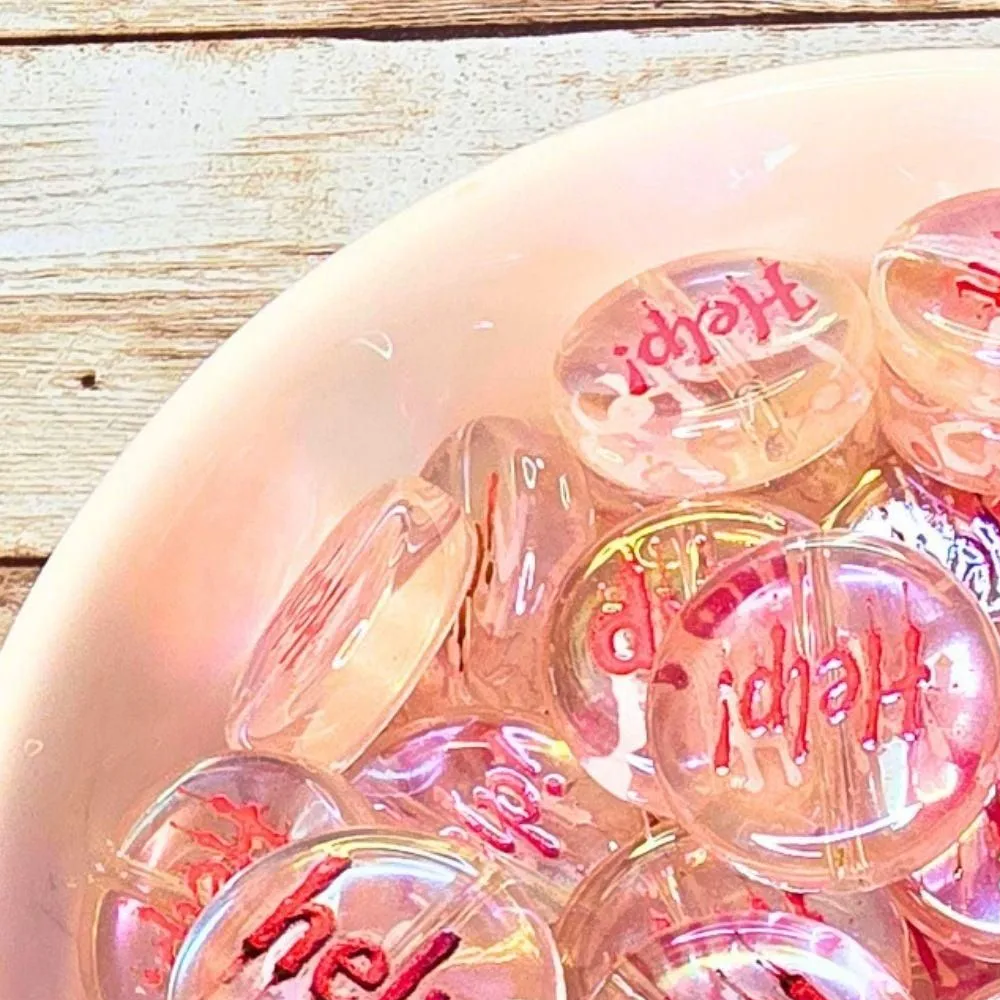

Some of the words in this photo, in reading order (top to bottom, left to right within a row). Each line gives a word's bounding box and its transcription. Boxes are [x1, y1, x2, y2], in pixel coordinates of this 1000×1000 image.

[612, 257, 818, 396] Help!
[713, 612, 930, 776] Help!
[439, 722, 567, 858] lp!
